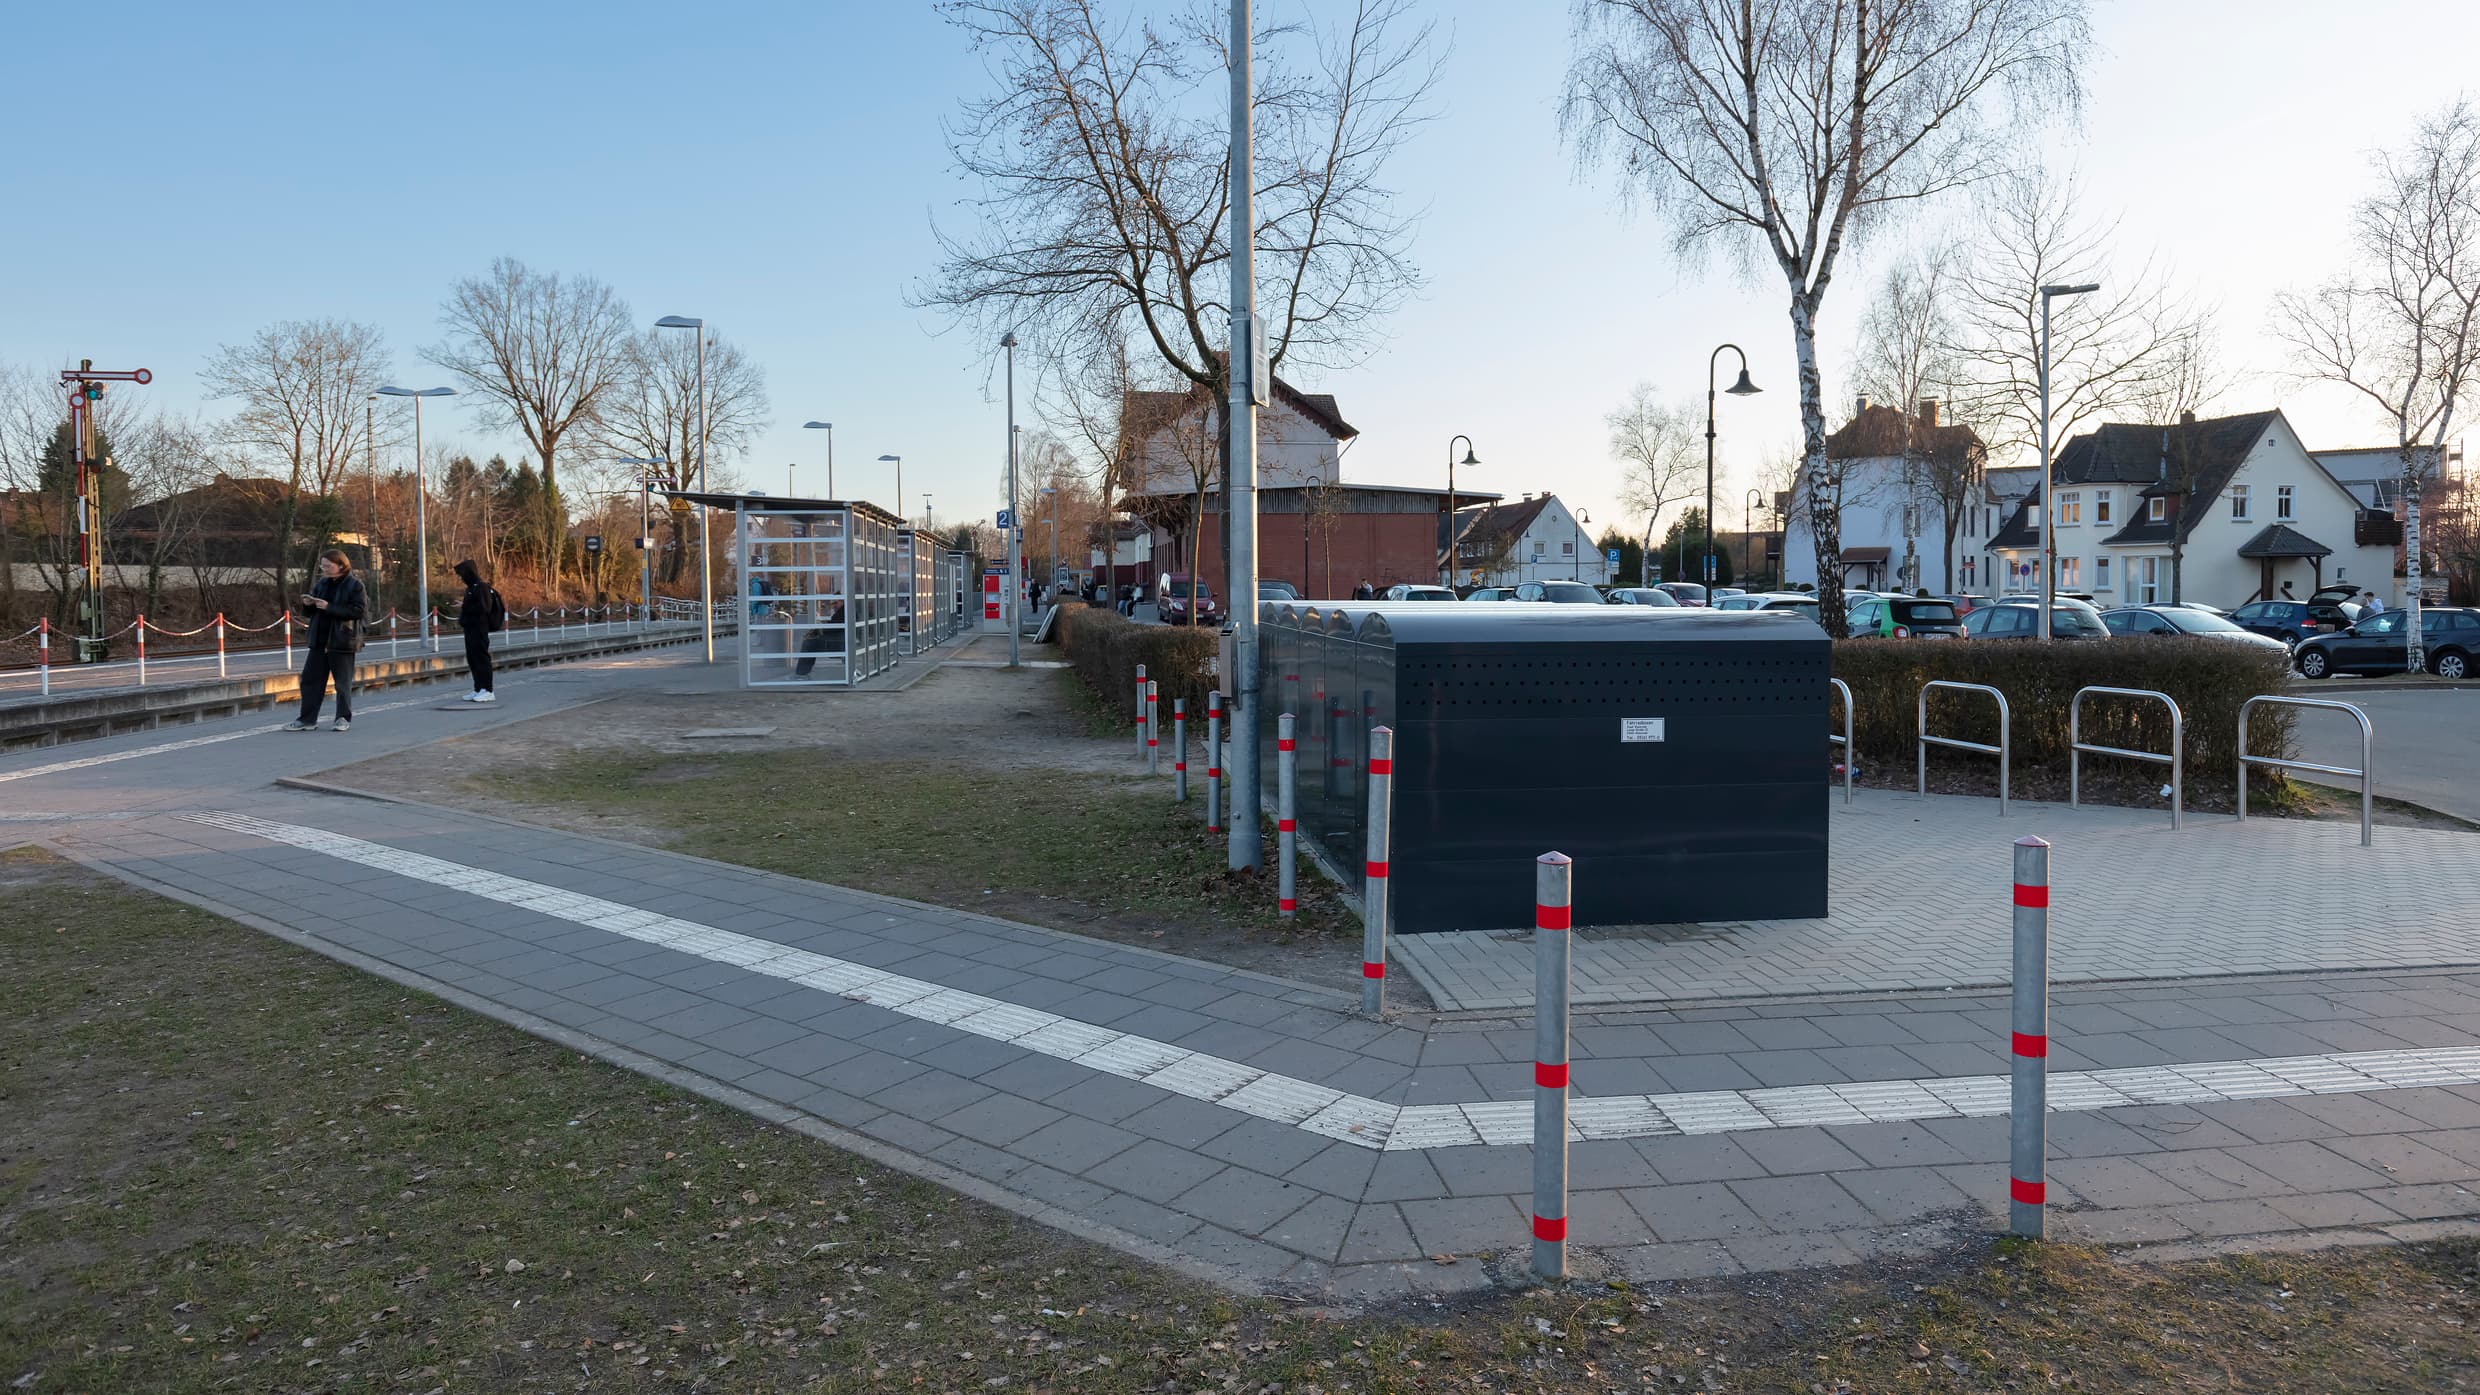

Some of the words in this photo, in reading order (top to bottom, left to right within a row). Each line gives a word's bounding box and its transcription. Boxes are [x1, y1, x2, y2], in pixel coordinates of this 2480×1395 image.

[999, 512, 1007, 525] 2
[1610, 551, 1617, 560] P
[756, 556, 761, 565] 3
